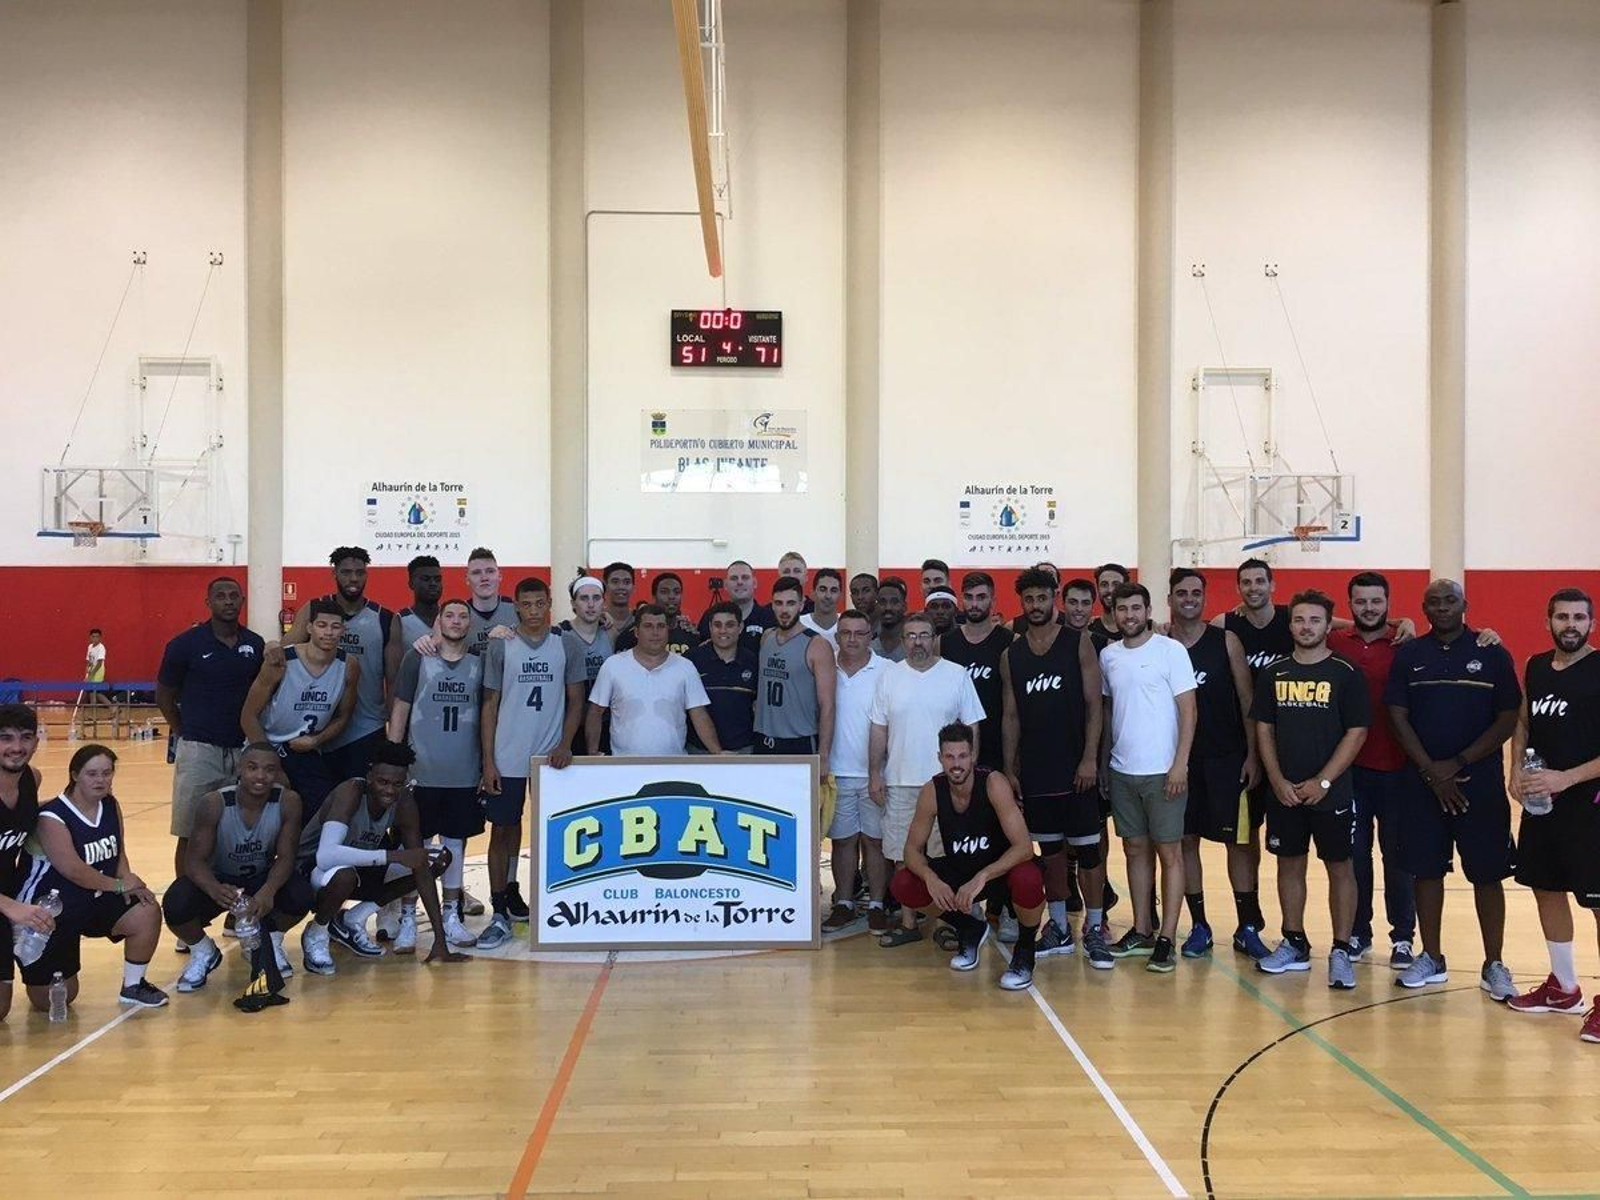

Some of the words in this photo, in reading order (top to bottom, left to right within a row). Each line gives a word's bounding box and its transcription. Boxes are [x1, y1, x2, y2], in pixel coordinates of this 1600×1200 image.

[676, 334, 705, 342] LOCAL
[748, 335, 777, 343] VISITANTE
[682, 346, 706, 363] 51
[756, 347, 778, 363] 71
[650, 438, 706, 449] POLIDEPORTIVO
[708, 438, 745, 449] CUBIERTO
[747, 438, 798, 449] MUNICIPAL
[372, 482, 413, 492] Alhaurín
[415, 482, 427, 492] de
[429, 482, 438, 492] la
[440, 482, 464, 492] Torre
[965, 485, 1004, 495] Alhaurín
[1006, 485, 1017, 495] de
[1020, 485, 1028, 495] la
[1030, 485, 1053, 495] Torre
[1340, 520, 1349, 530] 2
[341, 632, 360, 644] NCG
[522, 662, 549, 673] UNCG
[438, 682, 465, 693] UNCG
[1275, 680, 1332, 703] UNCG
[301, 691, 328, 702] UNCG
[526, 686, 543, 711] 4
[767, 681, 783, 707] 10
[443, 706, 458, 732] 11
[563, 805, 779, 871] CBAT
[83, 835, 118, 865] UNCG
[236, 840, 262, 853] UNCG
[603, 888, 639, 899] CLUB
[655, 887, 740, 899] BALONCESTO
[683, 912, 701, 923] de
[705, 910, 720, 923] la
[713, 900, 796, 928] Torre
